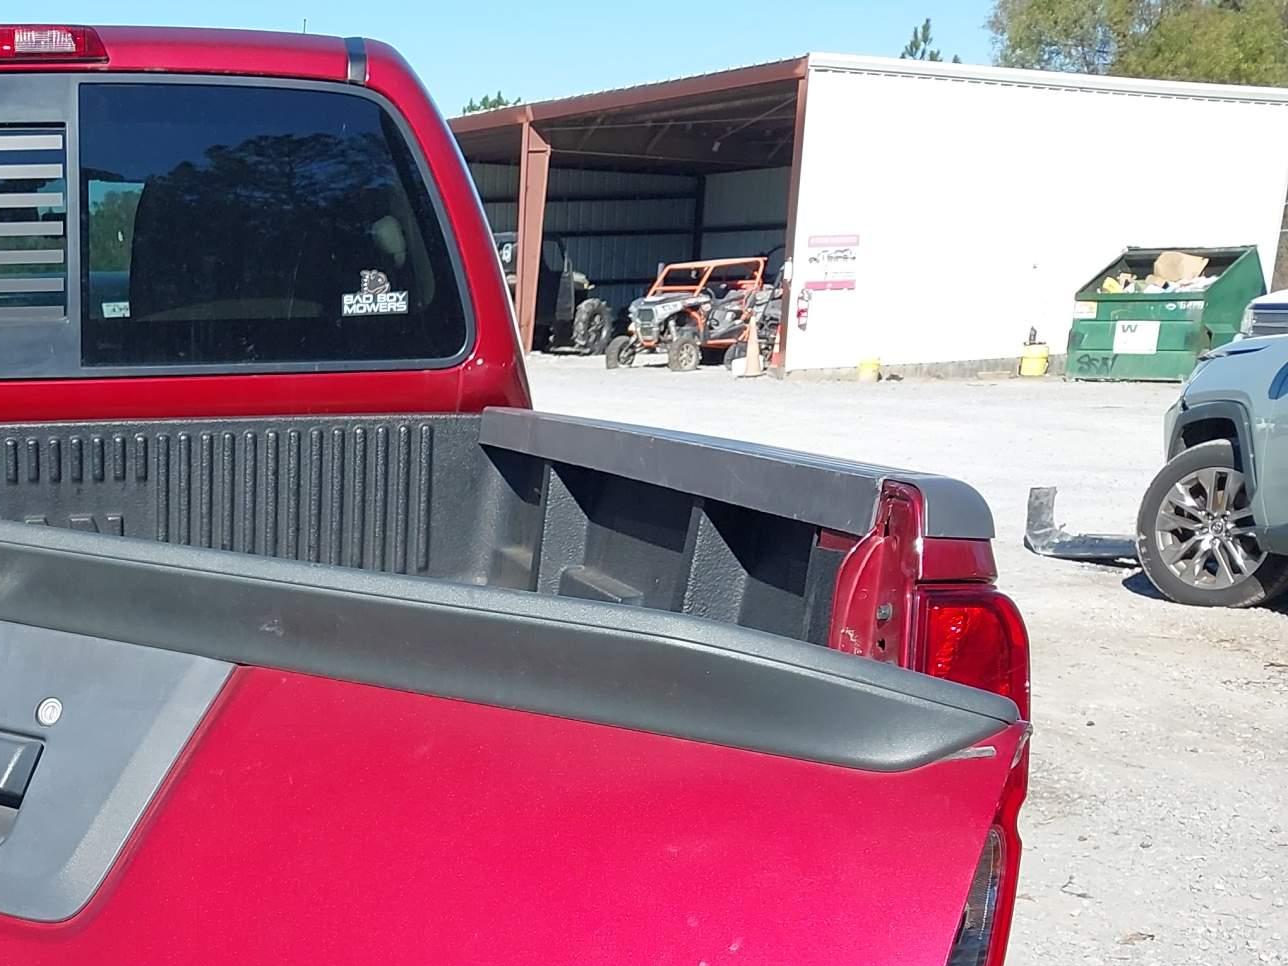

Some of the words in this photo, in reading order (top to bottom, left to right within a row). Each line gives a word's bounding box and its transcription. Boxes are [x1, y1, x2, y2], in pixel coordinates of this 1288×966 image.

[343, 294, 374, 305] BAD
[376, 291, 407, 304] BOY
[343, 301, 407, 315] MOWERS
